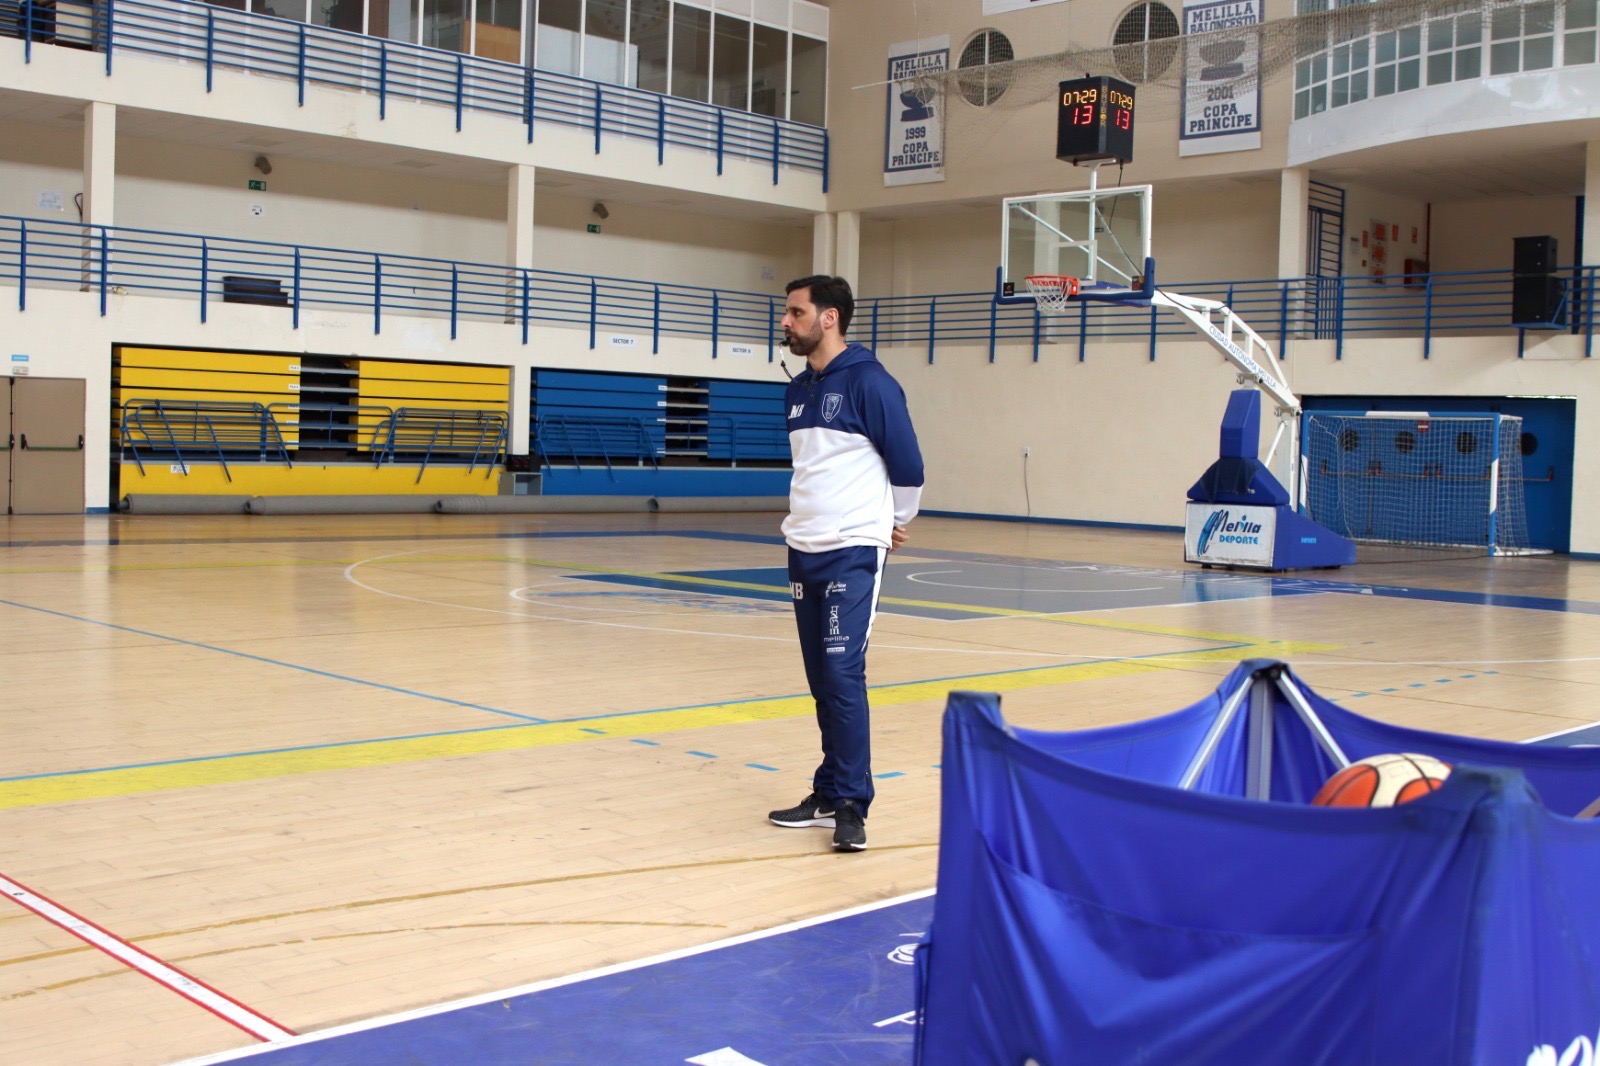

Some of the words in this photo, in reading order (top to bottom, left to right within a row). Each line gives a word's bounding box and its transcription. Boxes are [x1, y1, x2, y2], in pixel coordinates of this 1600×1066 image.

[1193, 1, 1253, 23] MELILLA
[1190, 14, 1257, 34] BALONCESTO
[895, 55, 942, 72] MELILLA
[1063, 88, 1097, 106] 07:29
[1110, 90, 1133, 110] 07:29
[1206, 85, 1234, 102] 2001
[1073, 105, 1094, 125] 13
[1115, 109, 1131, 130] 13
[1203, 103, 1238, 119] COPA
[1189, 113, 1252, 133] PRINCIPE
[905, 126, 926, 140] 1999
[902, 141, 929, 154] COPA
[891, 151, 940, 167] PRINCIPE
[1208, 325, 1229, 346] CIUDAD
[1229, 342, 1257, 372] AUTONOMA
[1258, 368, 1277, 389] MELILLA
[1219, 534, 1259, 545] DEPORTE
